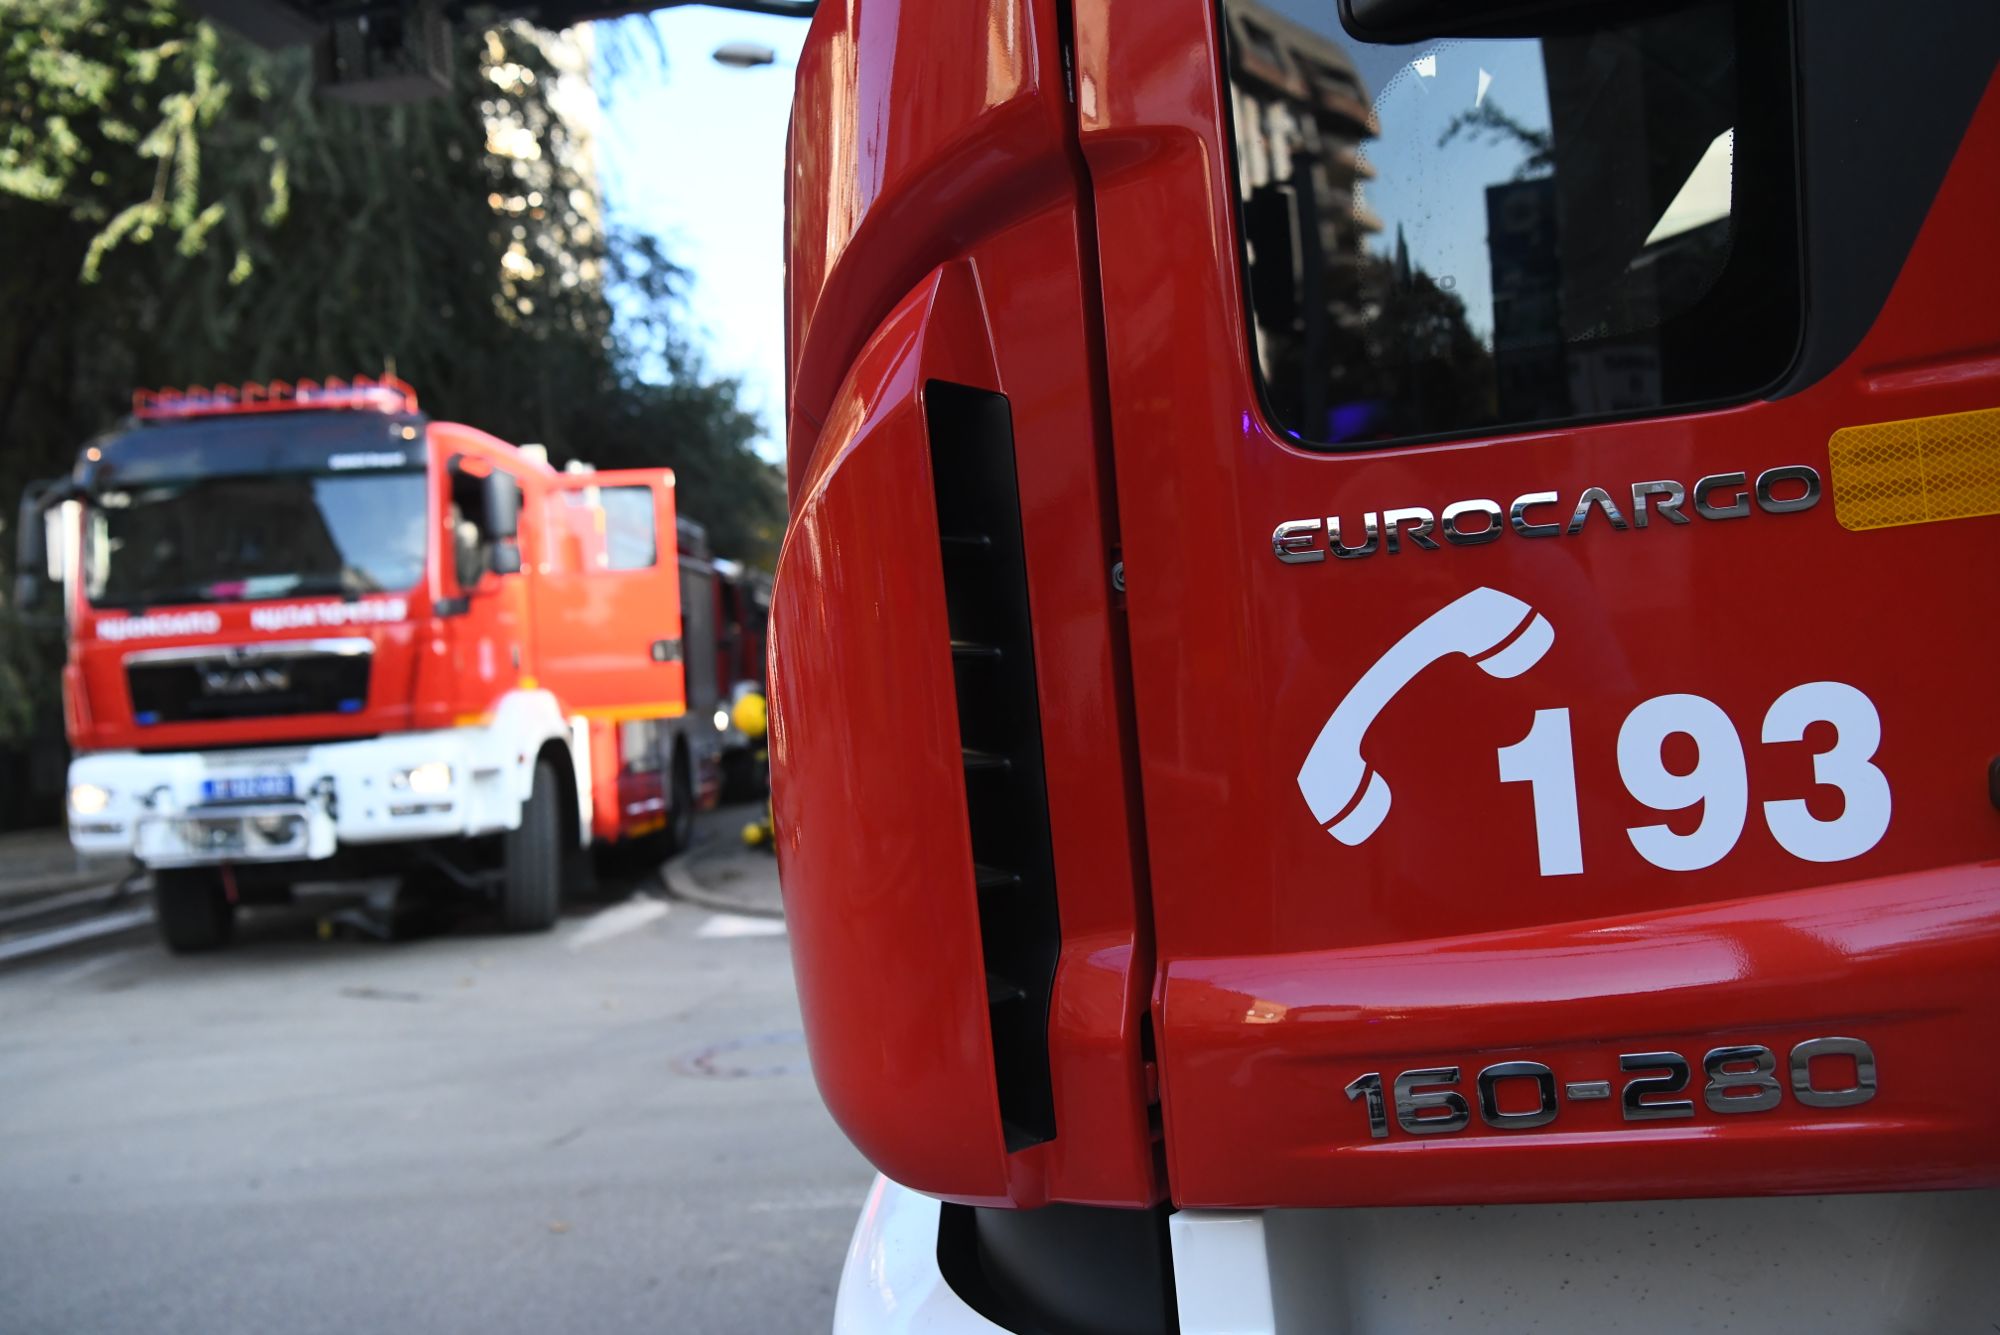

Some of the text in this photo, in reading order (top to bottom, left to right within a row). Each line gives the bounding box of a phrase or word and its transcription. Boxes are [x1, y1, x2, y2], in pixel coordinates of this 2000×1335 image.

[1272, 465, 1821, 564] EUROCARGO
[1498, 681, 1892, 876] 193
[1344, 1036, 1878, 1138] 160-280
